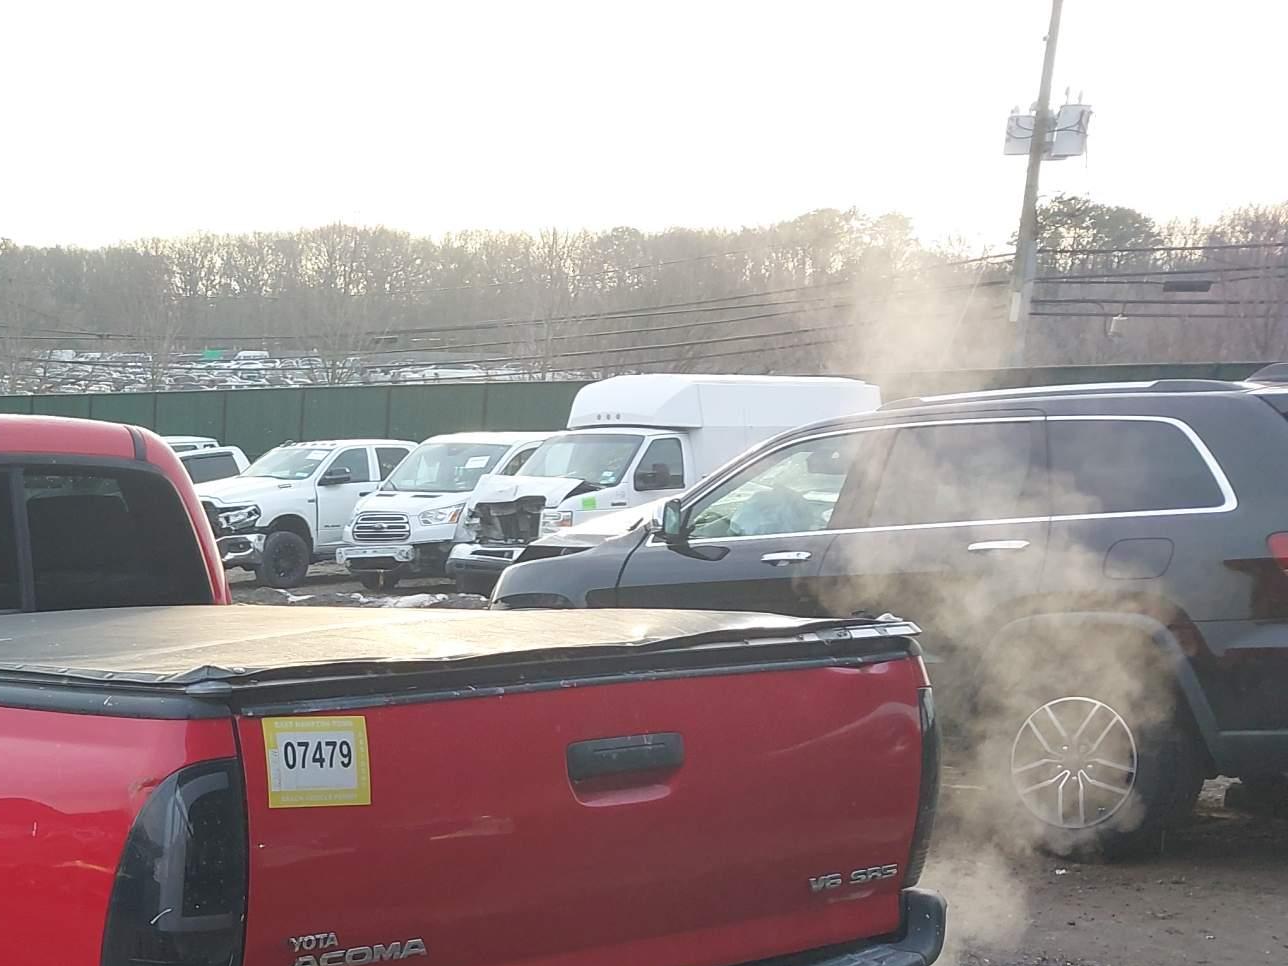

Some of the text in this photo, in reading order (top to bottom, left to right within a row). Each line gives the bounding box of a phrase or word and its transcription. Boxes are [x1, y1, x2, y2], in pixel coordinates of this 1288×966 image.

[283, 740, 353, 769] 07479
[808, 863, 898, 892] V6 SR5
[290, 932, 339, 953] YOTA
